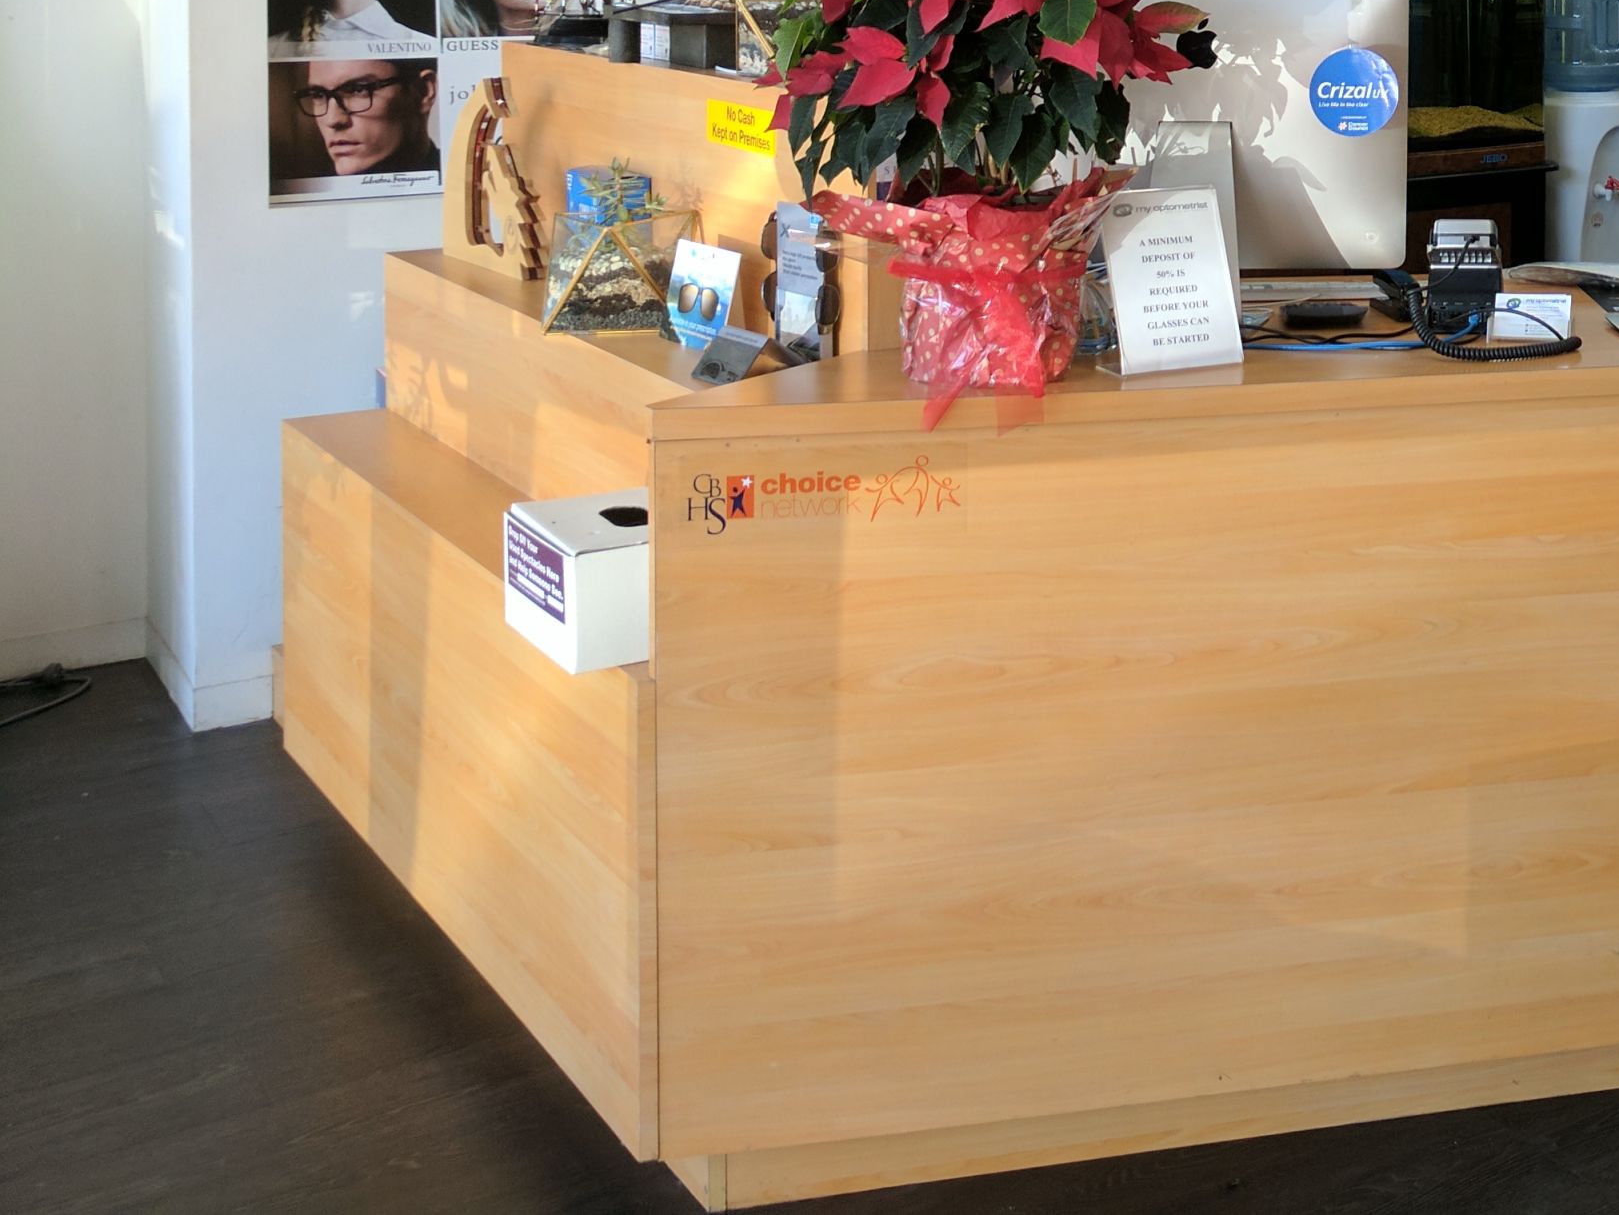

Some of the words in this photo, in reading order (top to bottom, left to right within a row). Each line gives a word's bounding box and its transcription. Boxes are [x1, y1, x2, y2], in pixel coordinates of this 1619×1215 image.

[367, 40, 433, 55] VALENTINO
[446, 40, 500, 52] GUESS
[1317, 82, 1372, 99] Crizal
[727, 106, 736, 121] No
[738, 109, 755, 126] Cash
[712, 122, 728, 142] Kept
[729, 131, 737, 142] on
[739, 130, 770, 150] Premises
[1136, 206, 1151, 214] my
[1153, 202, 1208, 212] optometrist
[1148, 236, 1193, 246] MINIMUM
[1142, 253, 1180, 263] DEPOSIT
[1183, 252, 1195, 260] OF
[1157, 271, 1174, 279] 50%
[1150, 285, 1198, 296] REQUIRED
[1144, 303, 1181, 313] BEFORE
[1183, 300, 1209, 309] YOUR
[1147, 320, 1189, 330] GLASSES
[1190, 317, 1210, 325] CAN
[1153, 338, 1166, 346] BE
[1169, 334, 1210, 345] STARTED
[760, 470, 862, 496] choice
[760, 493, 862, 520] network
[527, 538, 538, 554] Your
[520, 547, 546, 573] Spectacles
[546, 565, 559, 583] Here
[518, 560, 528, 576] Help
[529, 568, 551, 592] Someone
